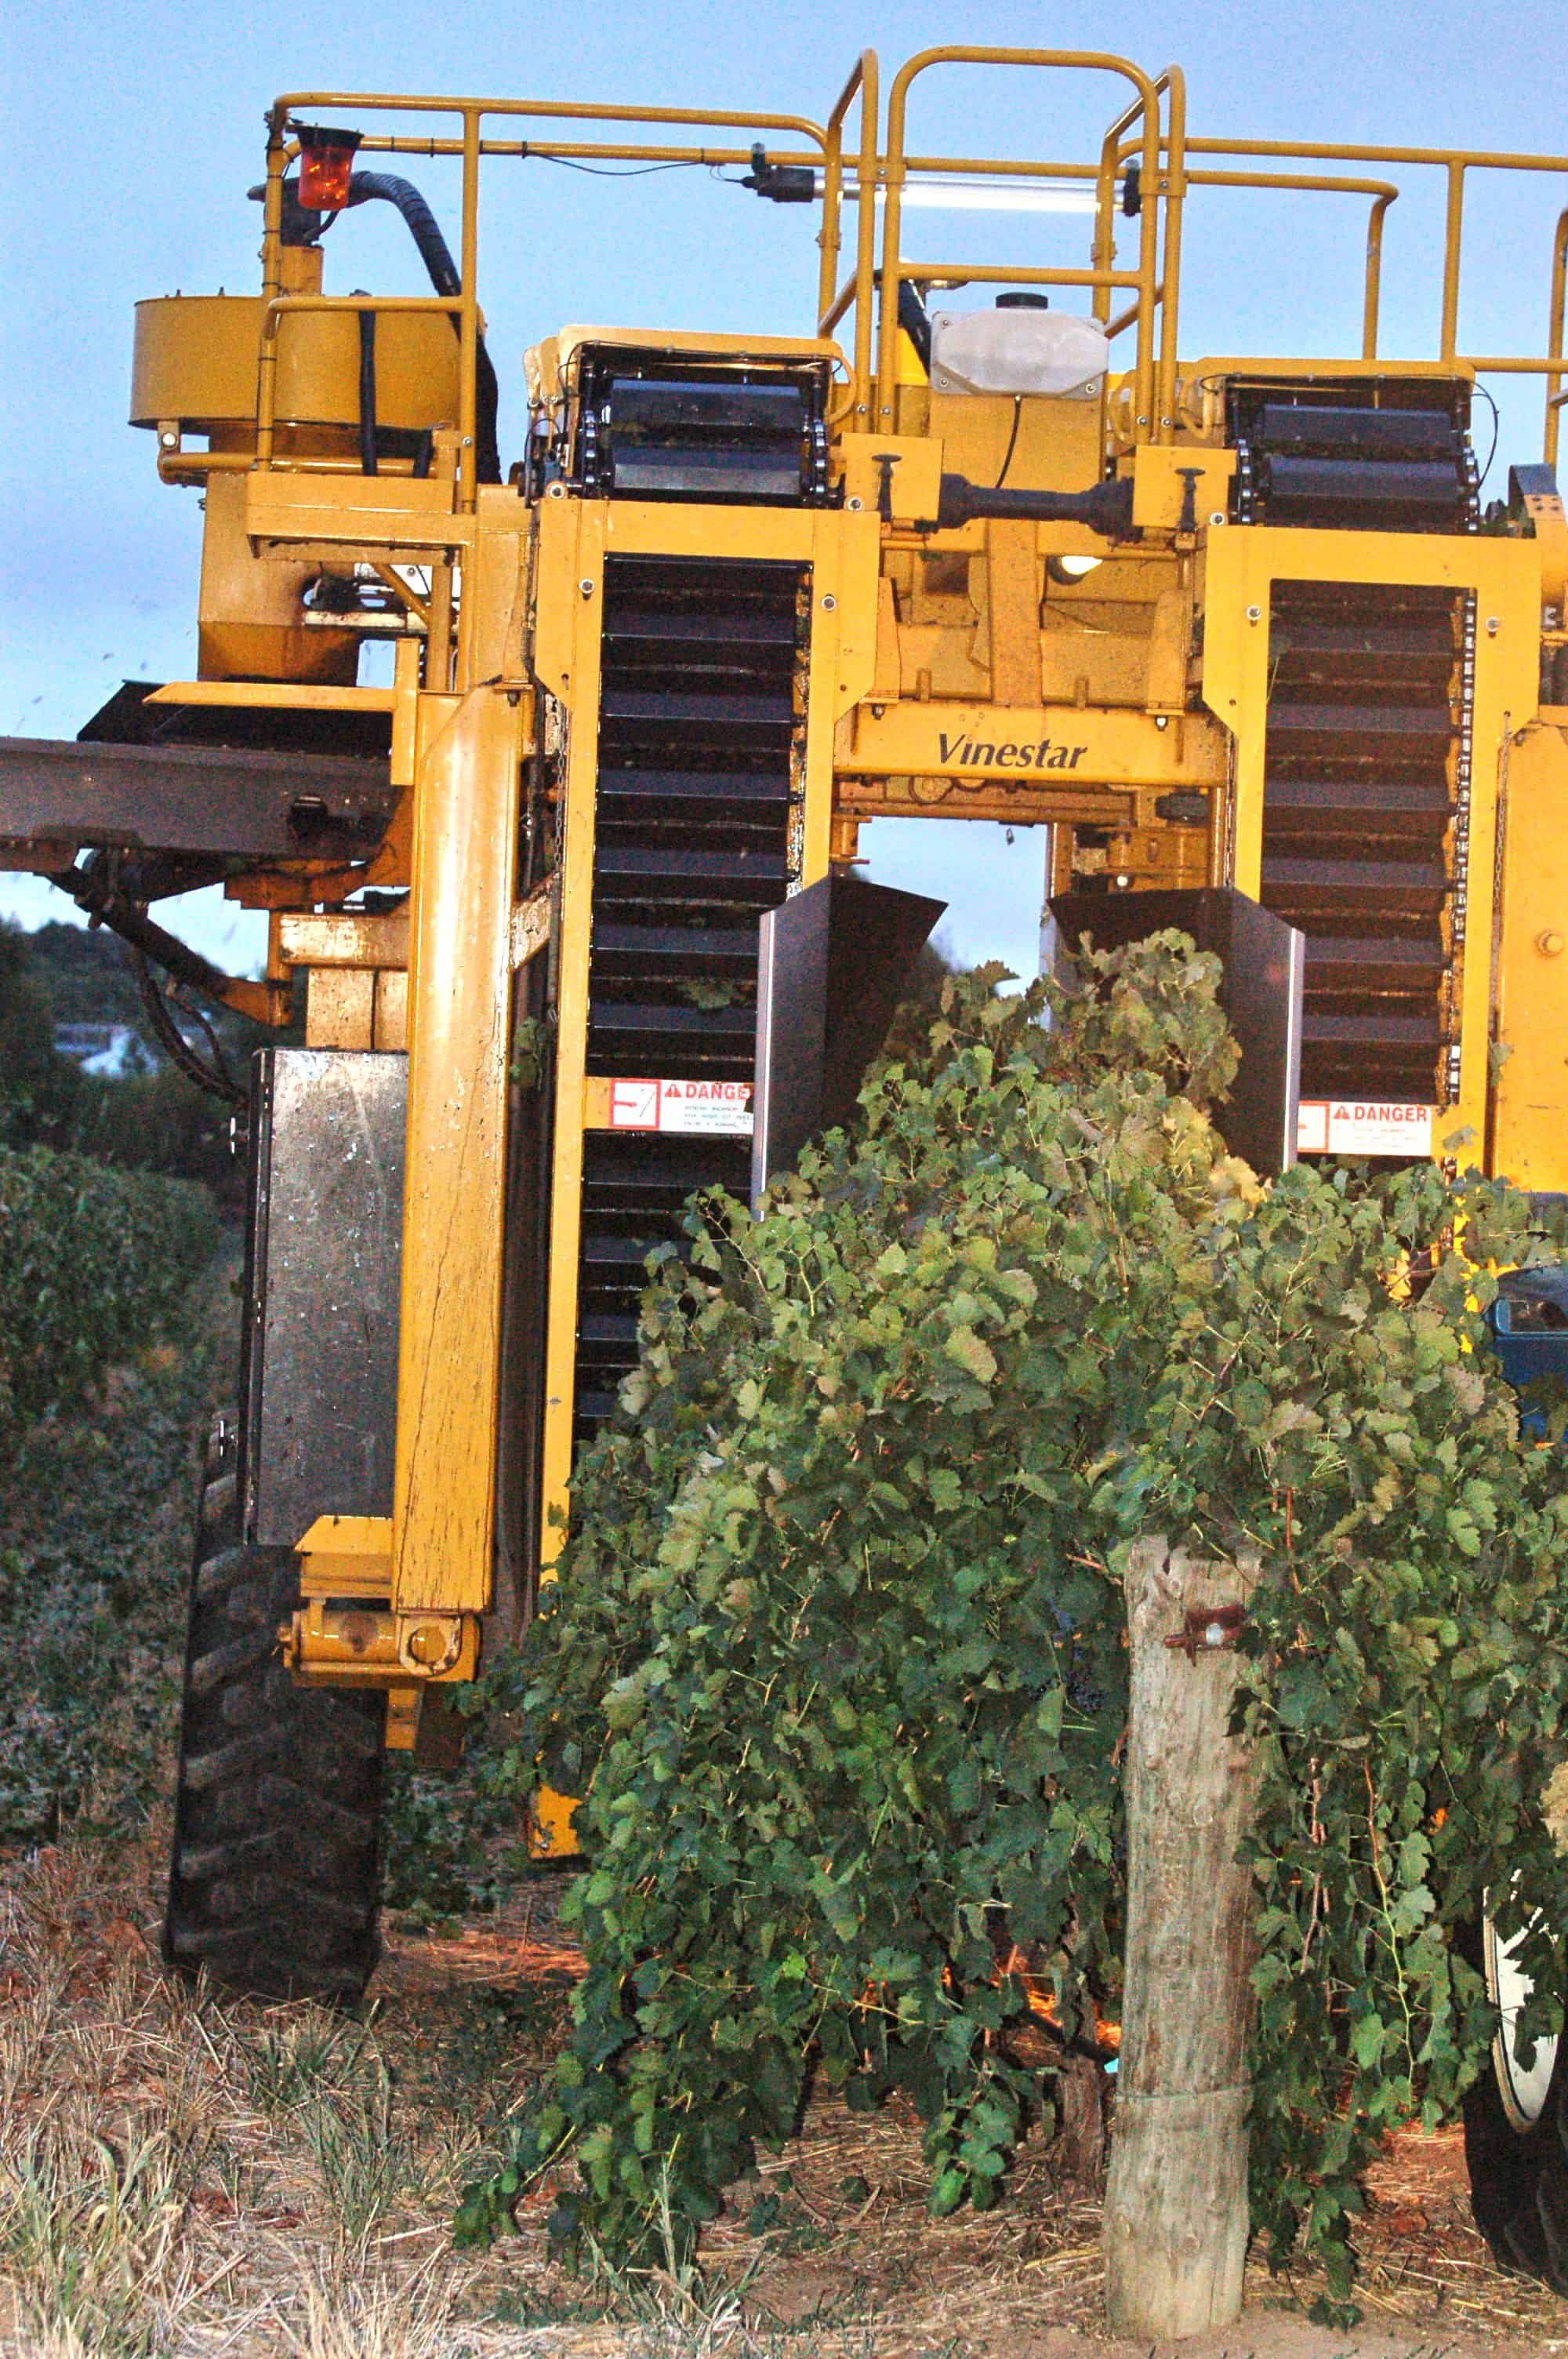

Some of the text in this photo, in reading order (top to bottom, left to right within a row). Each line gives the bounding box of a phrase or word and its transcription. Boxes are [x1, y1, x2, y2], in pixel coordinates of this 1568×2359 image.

[939, 733, 1088, 769] Vinestar
[685, 1084, 753, 1100] DANGE
[1354, 1106, 1428, 1122] DANGER
